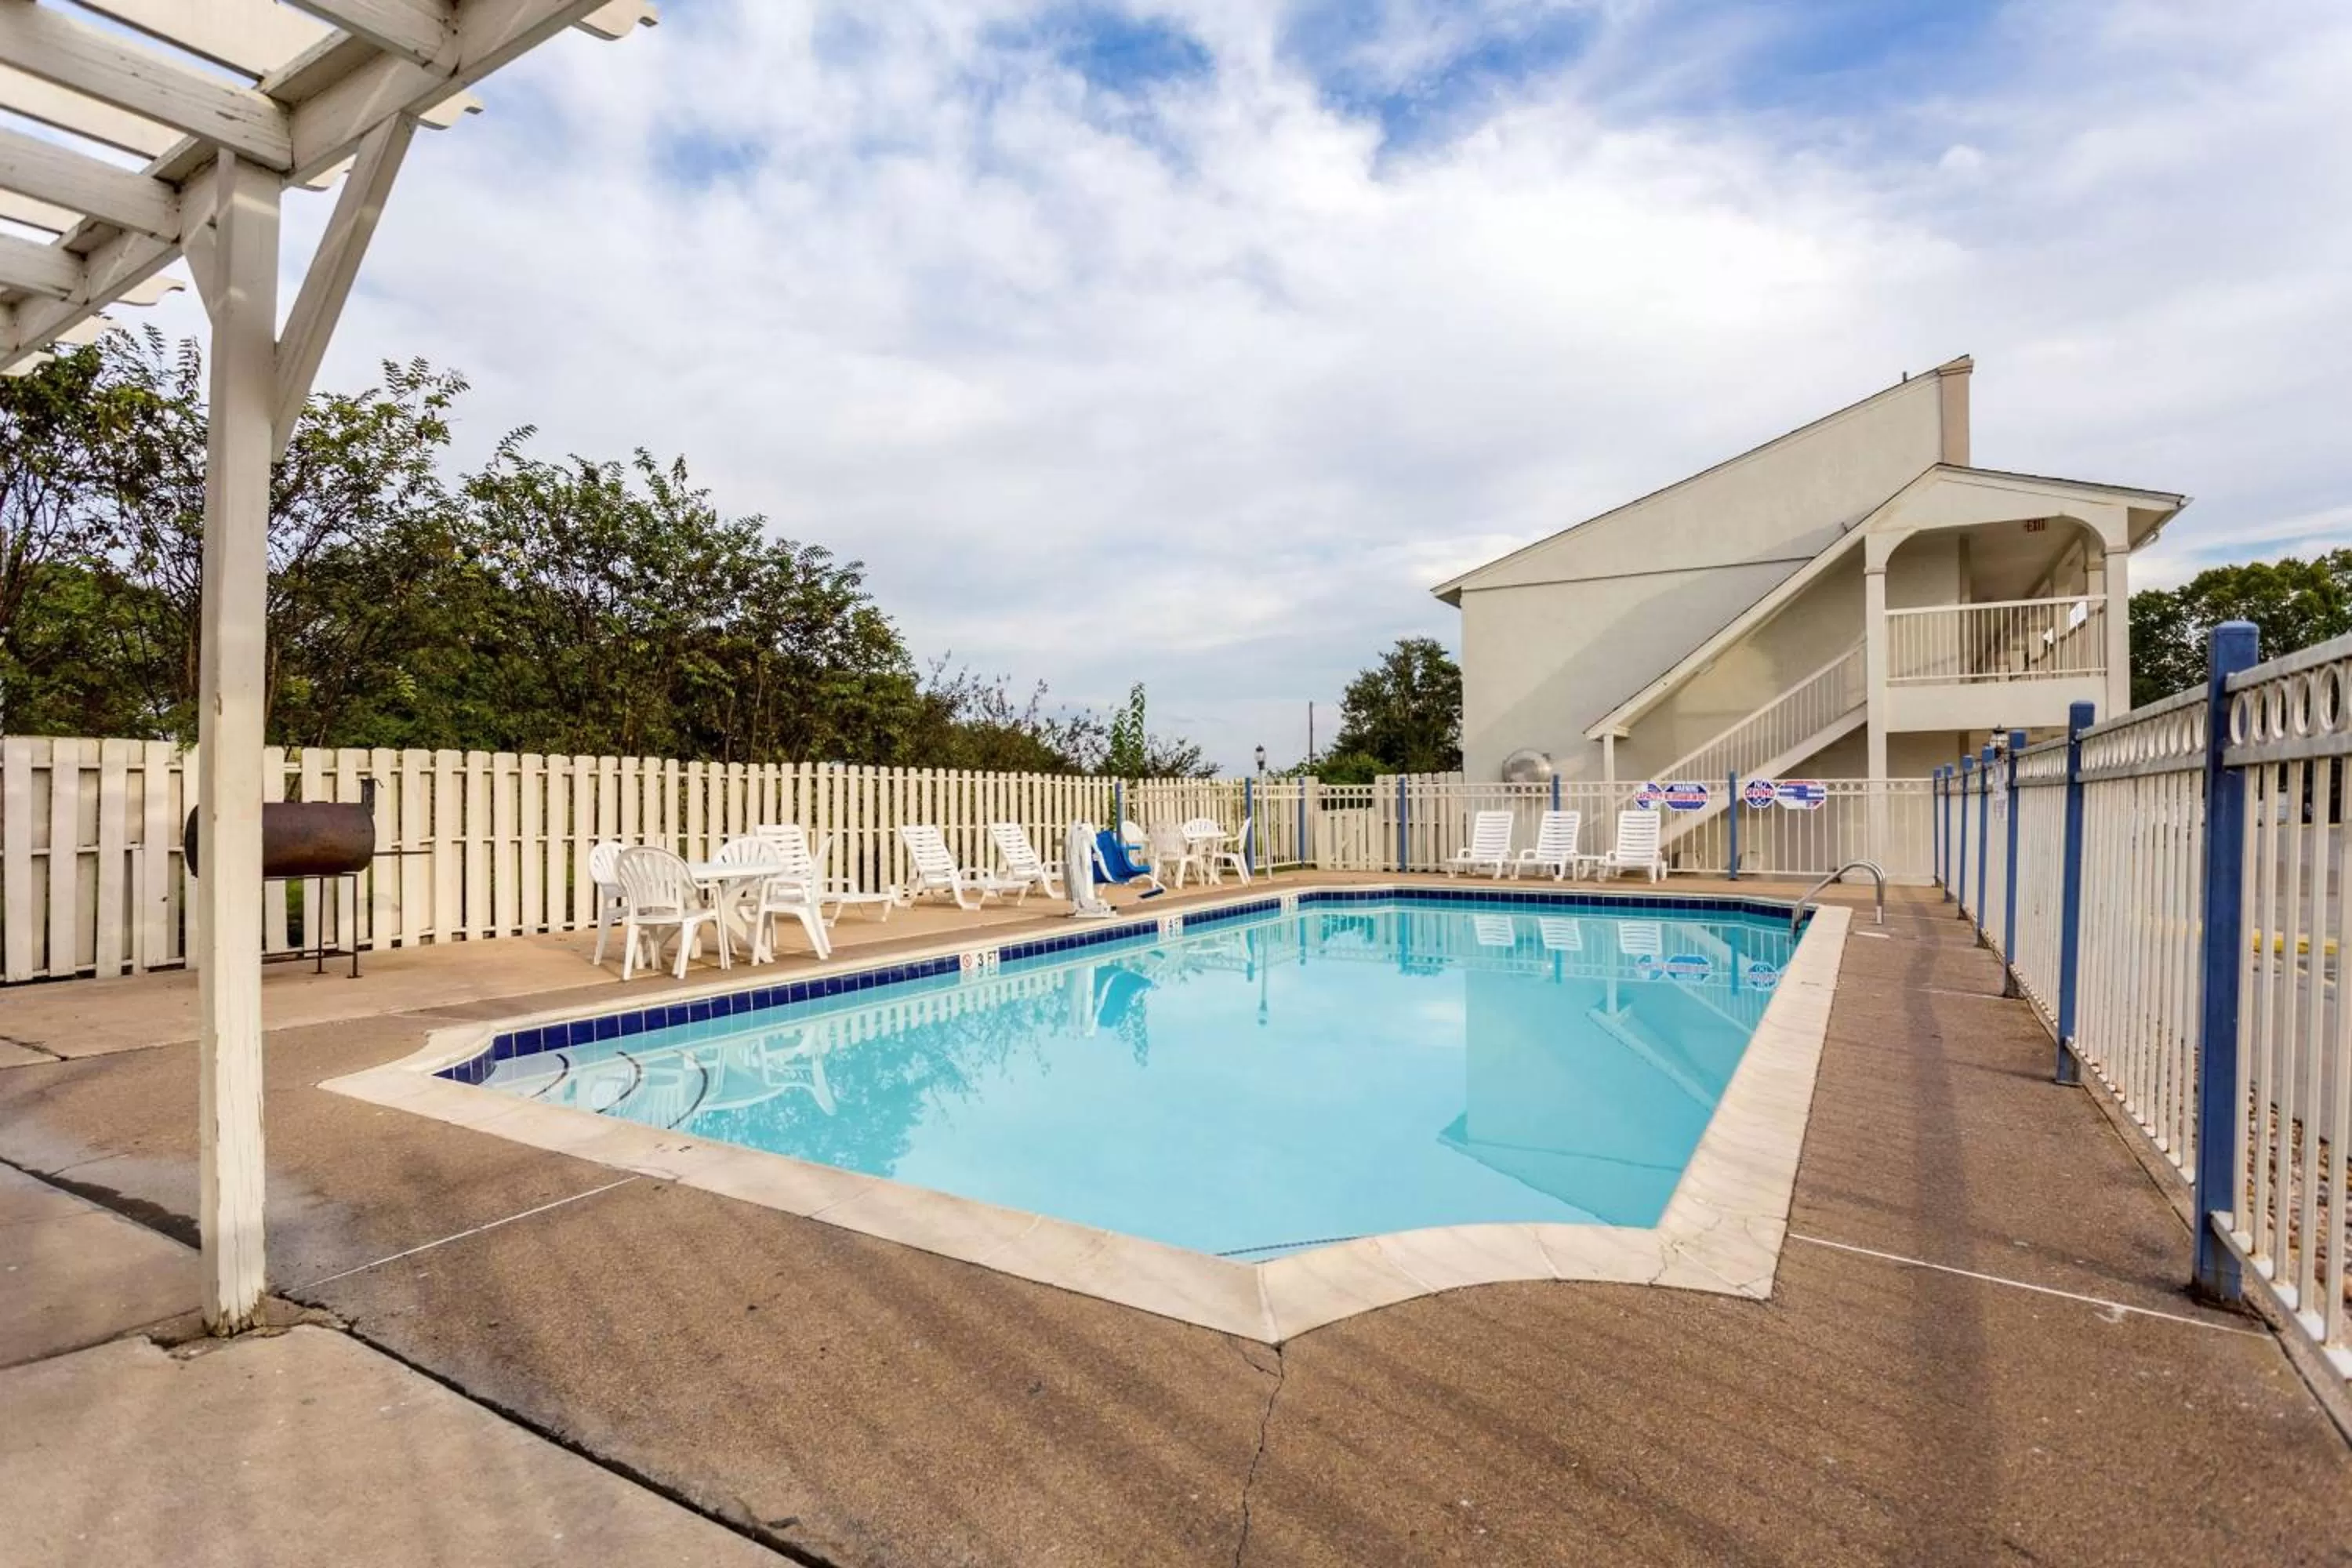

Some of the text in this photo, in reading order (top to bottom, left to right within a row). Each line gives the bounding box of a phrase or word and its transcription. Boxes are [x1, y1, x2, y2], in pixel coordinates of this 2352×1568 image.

[2026, 518, 2046, 532] EXIT
[1755, 780, 1768, 789] NO
[1745, 789, 1775, 797] DIVING
[978, 950, 998, 967] 3 FT
